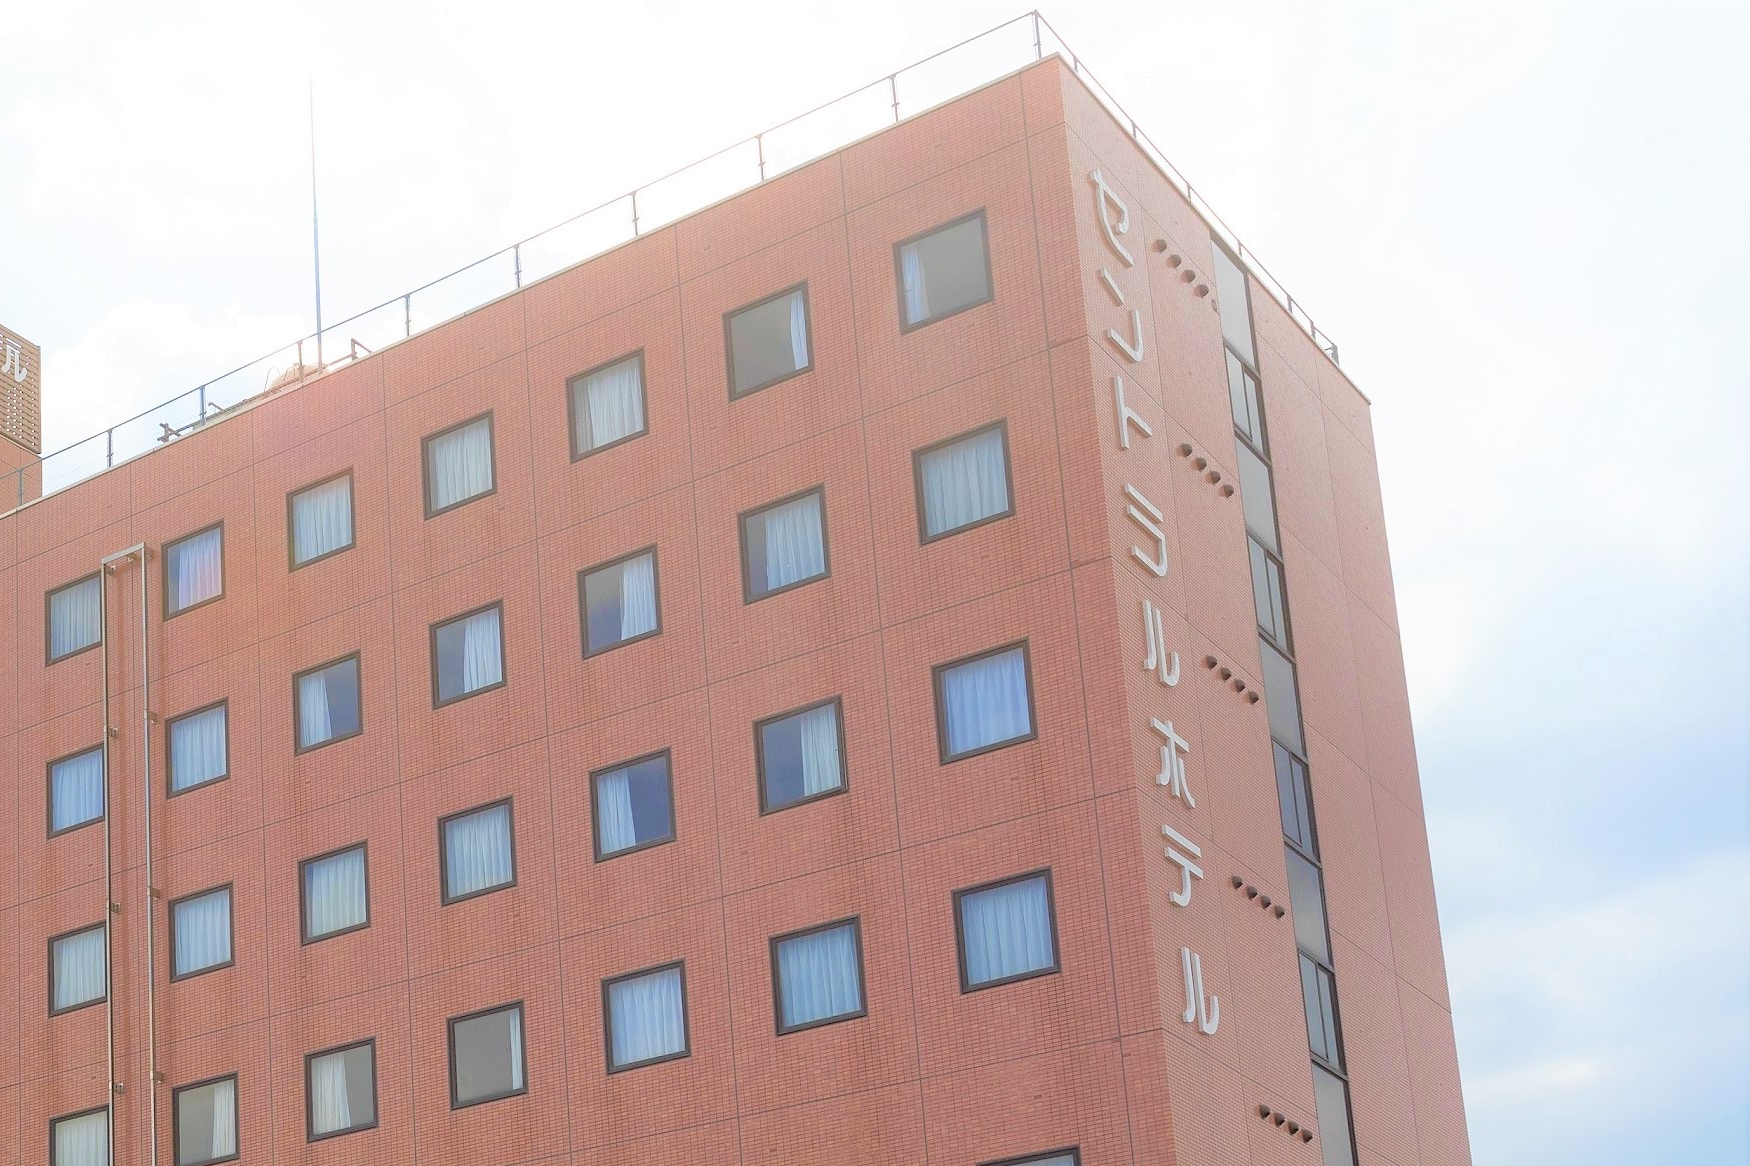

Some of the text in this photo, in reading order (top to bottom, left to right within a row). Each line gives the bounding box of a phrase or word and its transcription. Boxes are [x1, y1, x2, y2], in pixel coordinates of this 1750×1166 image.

[1090, 168, 1219, 1035] セントラルホテル
